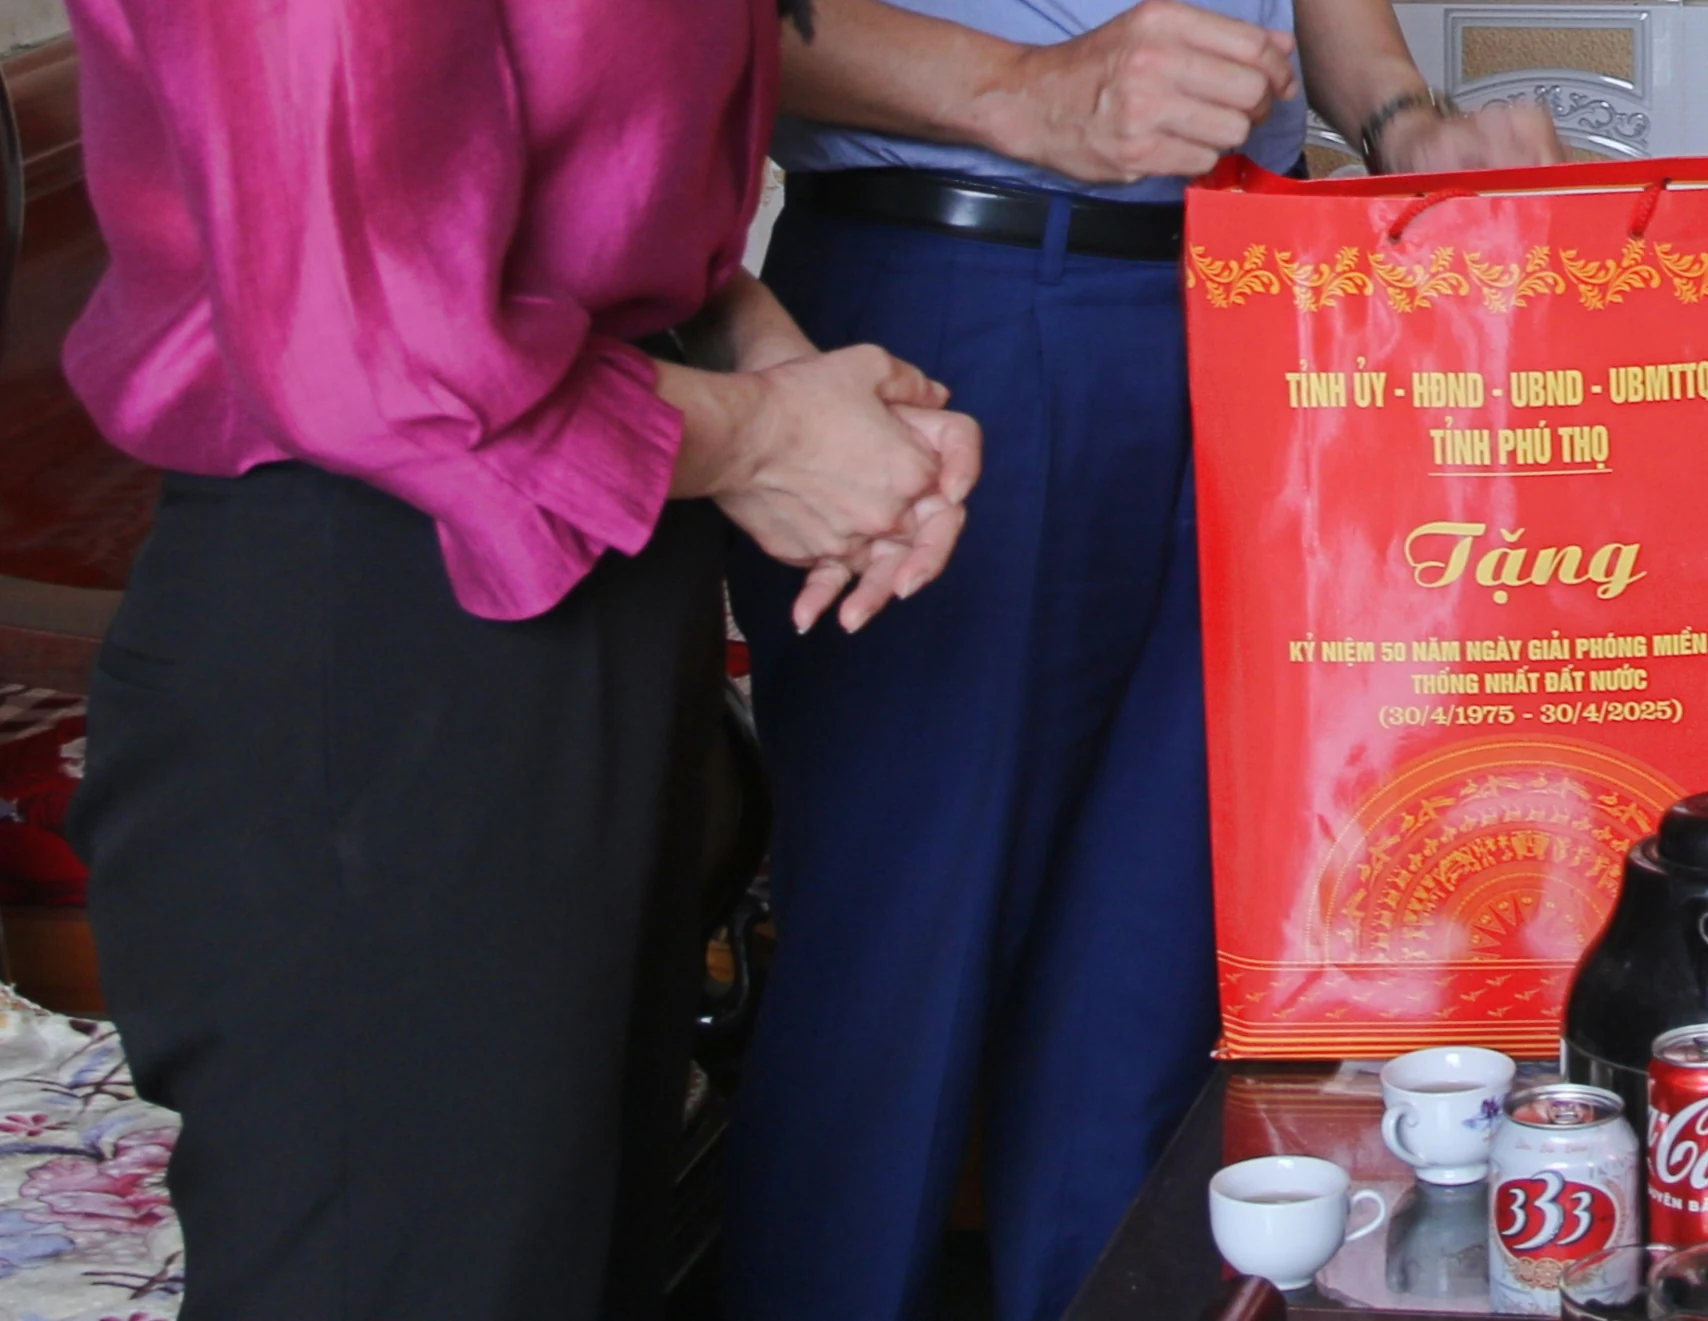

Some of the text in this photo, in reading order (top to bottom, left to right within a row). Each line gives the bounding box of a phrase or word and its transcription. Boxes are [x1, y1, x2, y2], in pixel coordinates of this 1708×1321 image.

[1285, 358, 1347, 408] TỈNH
[1353, 356, 1387, 408] ỦY
[1394, 388, 1405, 397] -
[1412, 371, 1485, 408] HĐND
[1492, 388, 1503, 397] -
[1509, 369, 1584, 408] UBND
[1591, 385, 1603, 394] -
[1429, 415, 1609, 470] TỈNH PHÚ THỌ
[1404, 521, 1648, 605] Tặng
[1289, 632, 1316, 662] KỶ
[1321, 637, 1376, 667] NIỆM
[1381, 641, 1406, 662] 50
[1412, 636, 1461, 662] NĂM
[1466, 636, 1523, 662] NGÀY
[1527, 630, 1570, 660] GIẢI
[1575, 632, 1647, 659] PHÓNG
[1652, 625, 1708, 657] MIỀN
[1411, 663, 1648, 695] THỐNG NHẤT ĐẤT NƯỚC
[1378, 705, 1515, 729] (30/4/1975
[1540, 698, 1683, 724] 30/4/2025)
[1501, 1169, 1594, 1251] 333
